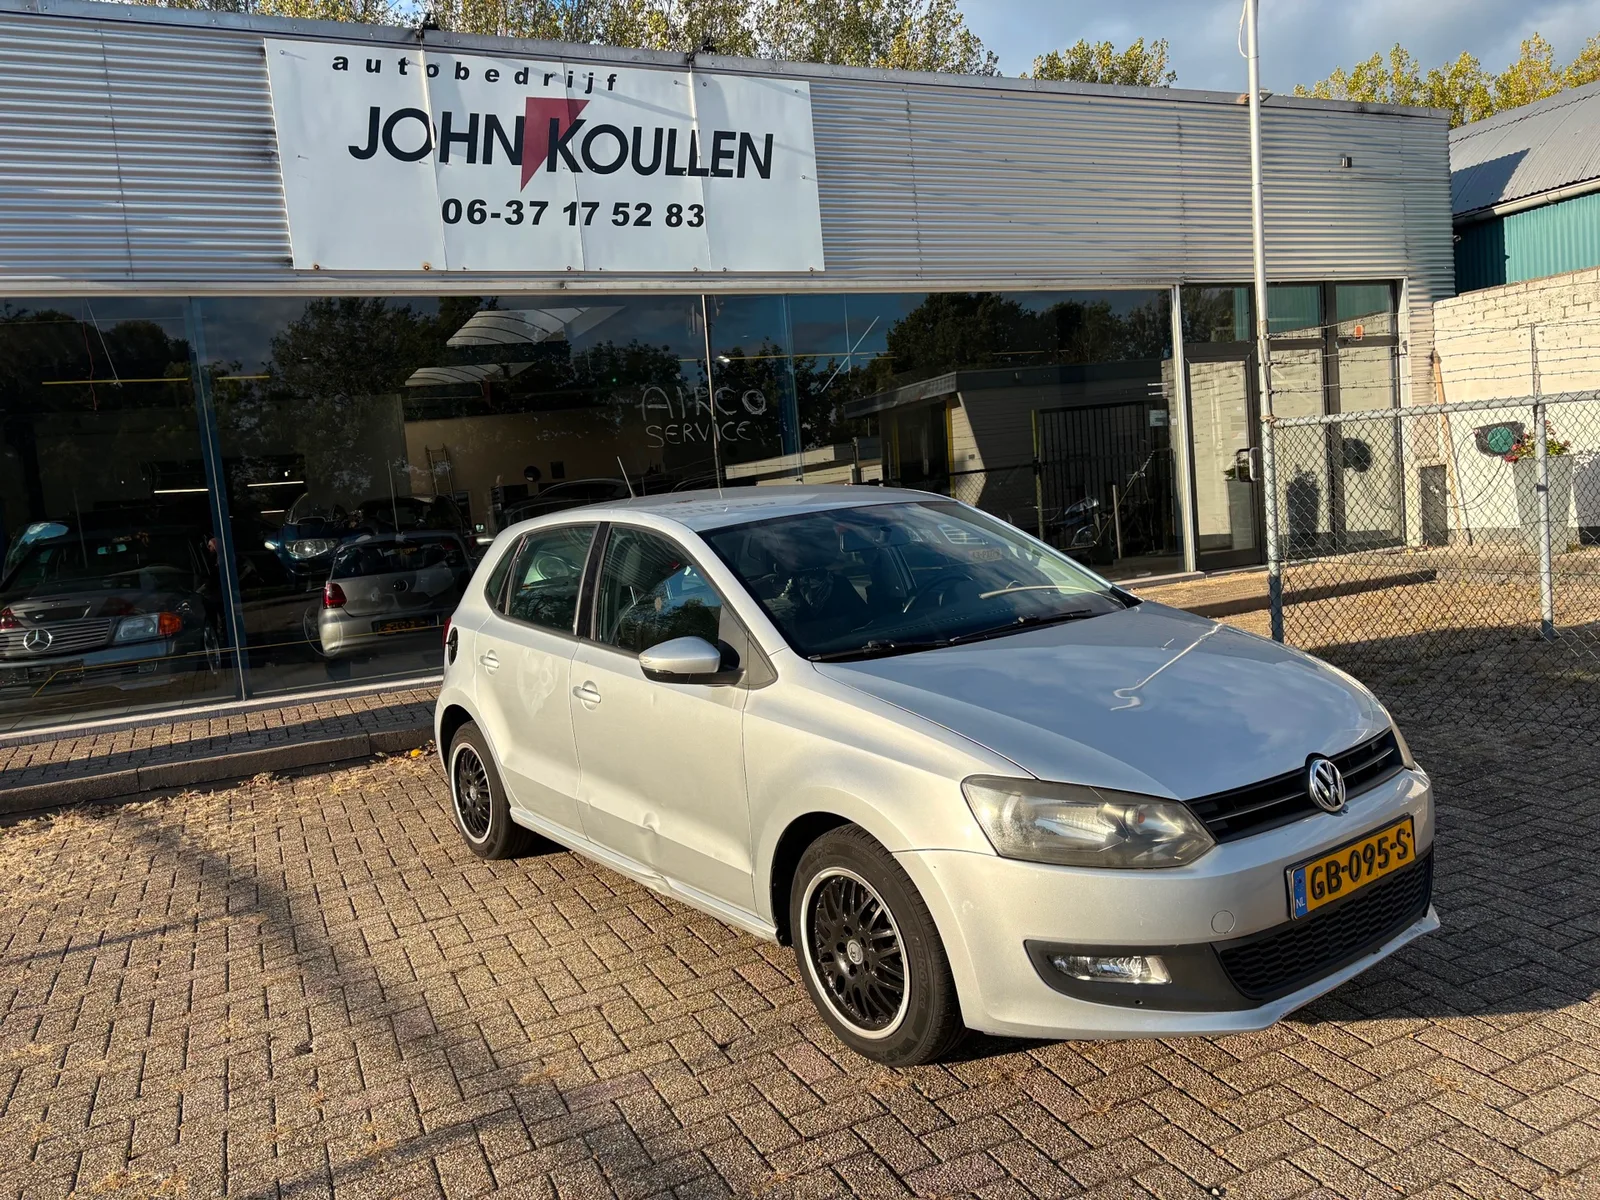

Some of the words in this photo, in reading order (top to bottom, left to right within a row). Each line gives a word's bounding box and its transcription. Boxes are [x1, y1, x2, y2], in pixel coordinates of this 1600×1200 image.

[332, 55, 617, 94] autobedrijf
[348, 106, 526, 166] JOHN
[546, 117, 774, 179] KOULLEN
[442, 198, 549, 226] 06-37
[563, 201, 600, 227] 17
[611, 202, 653, 227] 52
[665, 203, 705, 228] 83
[635, 386, 767, 421] AIRCO
[646, 421, 751, 448] SERVICE
[1311, 828, 1408, 900] GB-095-S
[1296, 897, 1306, 908] NL
